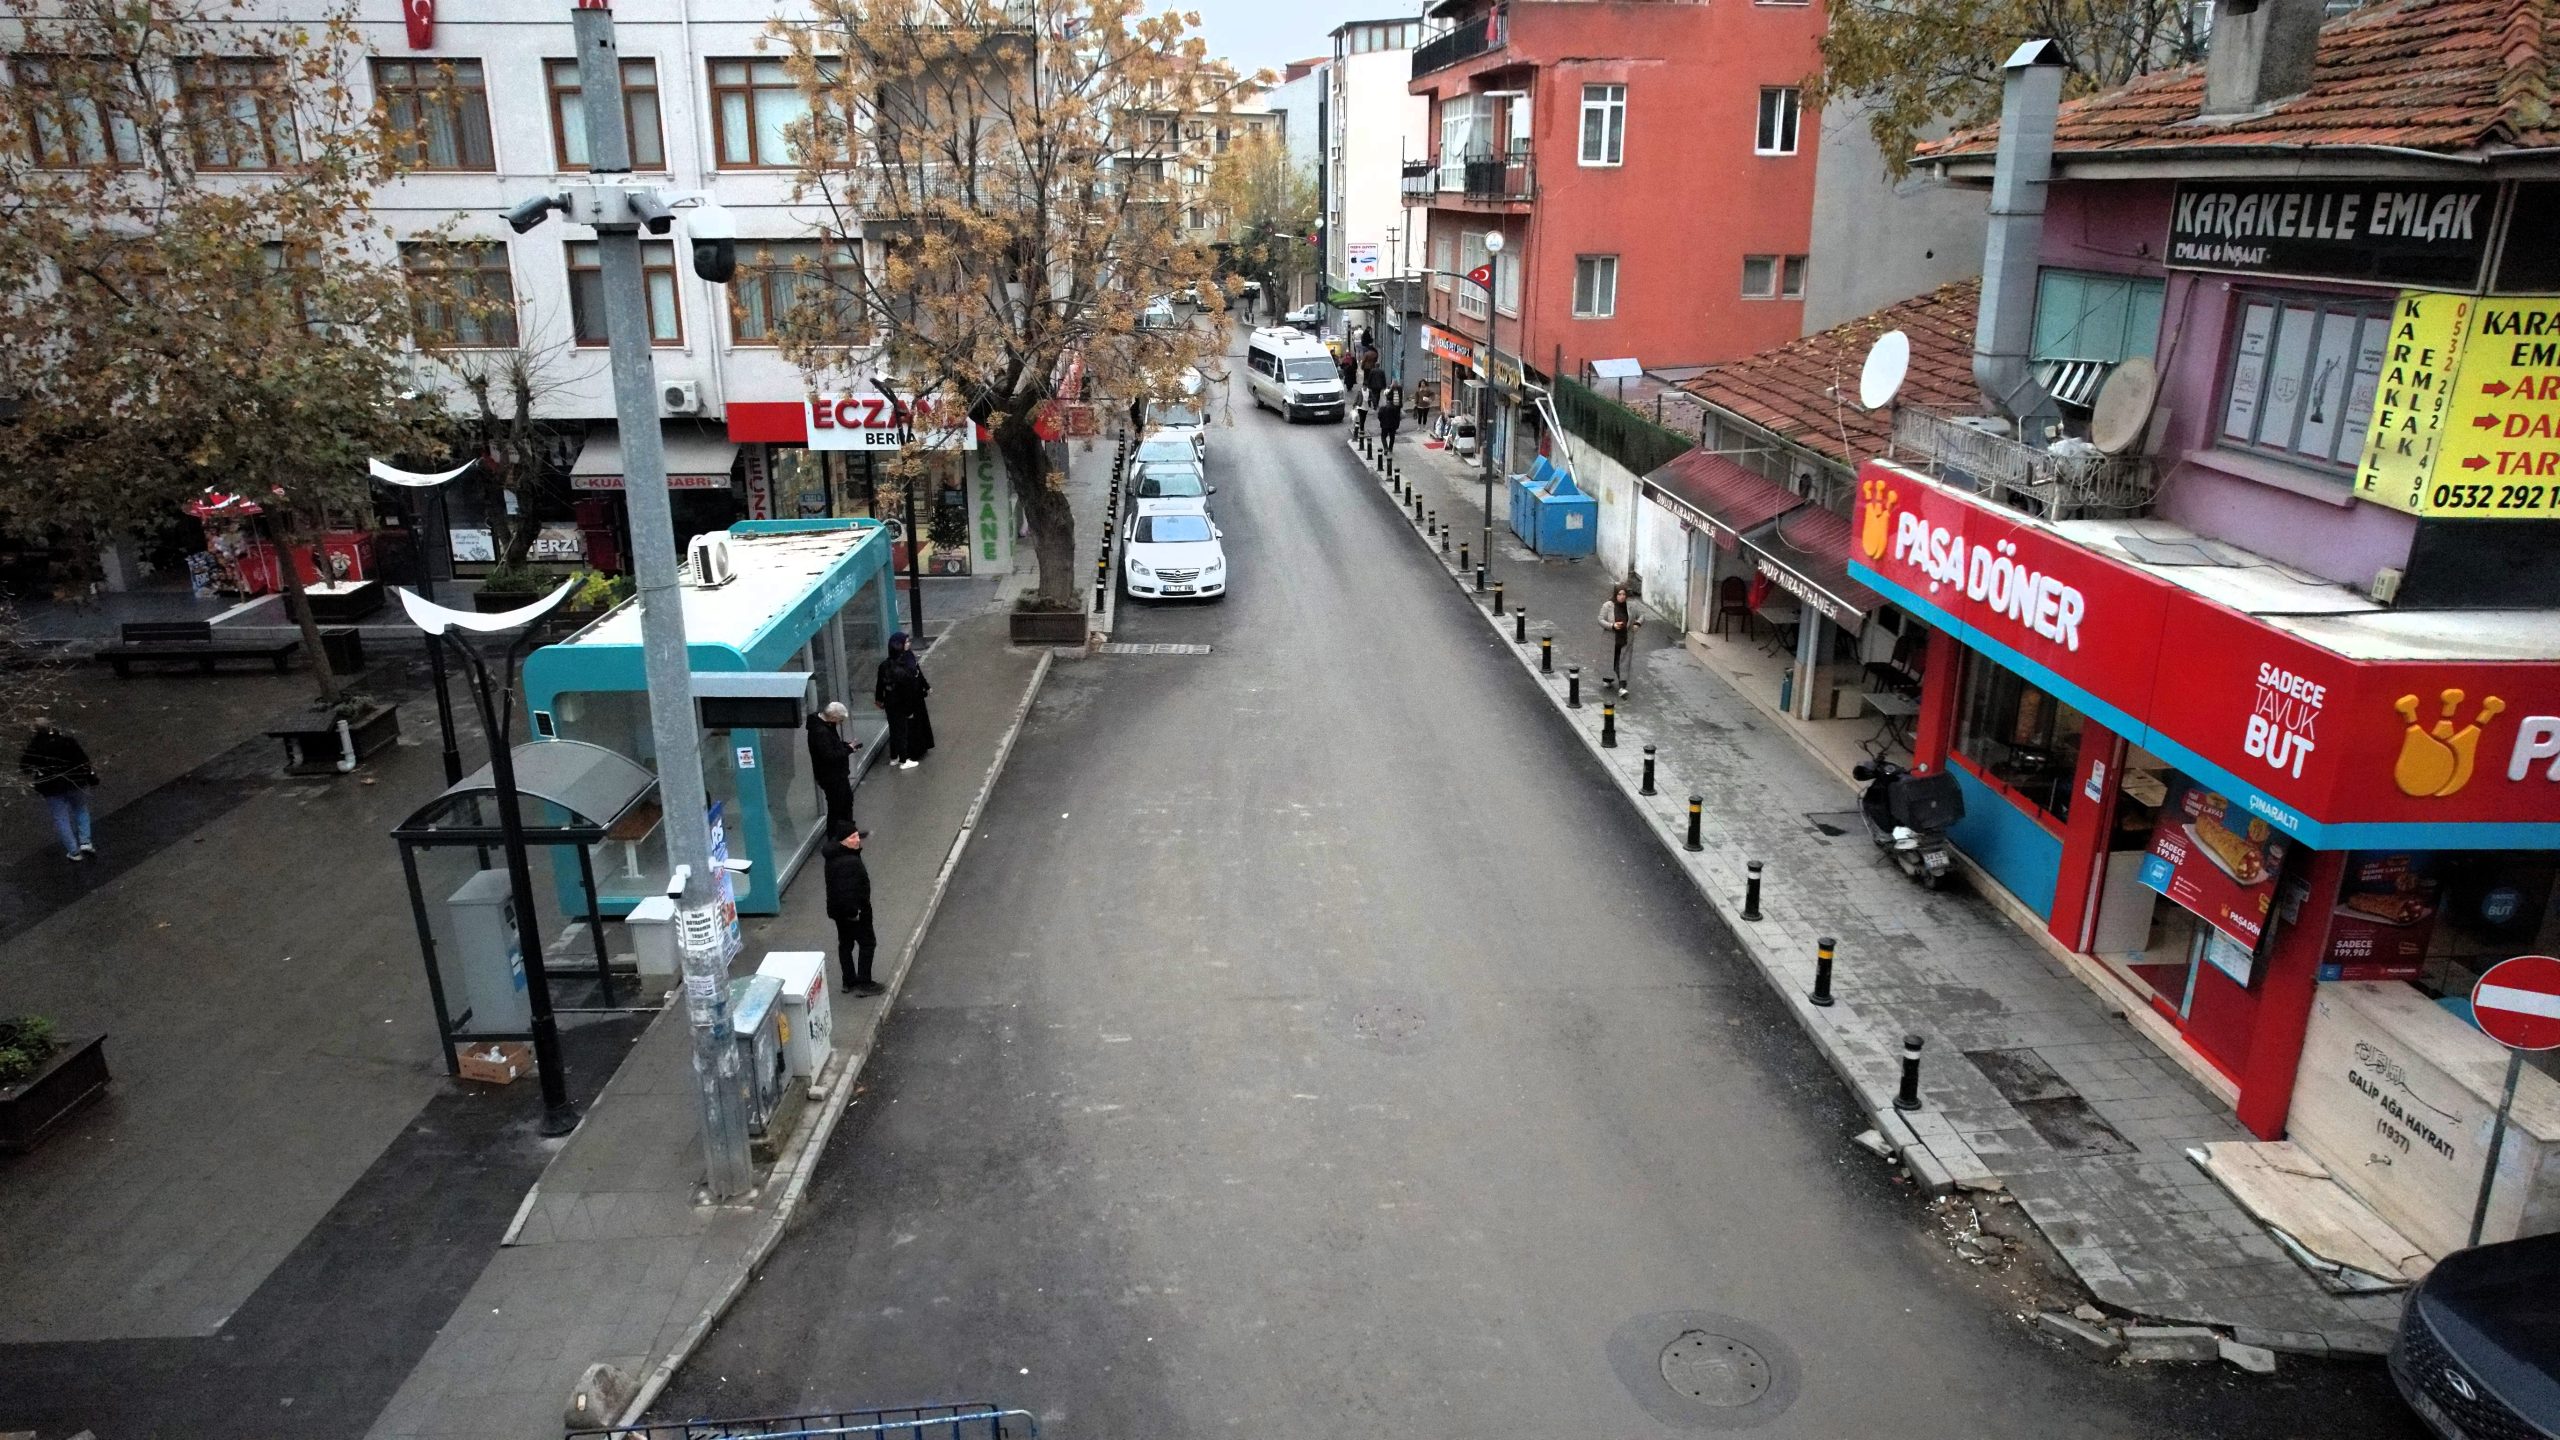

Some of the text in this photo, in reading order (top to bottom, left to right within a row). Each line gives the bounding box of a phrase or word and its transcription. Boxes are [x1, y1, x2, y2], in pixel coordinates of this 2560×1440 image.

[2175, 192, 2481, 243] KARAKELLE EMLAK
[2175, 242, 2210, 260] EMLAK
[2511, 342, 2560, 367] EM
[2363, 299, 2421, 493] KARAKELLE
[2397, 348, 2435, 457] EMLAK
[588, 477, 625, 488] KUA
[2433, 484, 2560, 509] 0532 292 1
[1895, 511, 2085, 652] PAŞA DÖNER
[2257, 662, 2326, 709] SADECE
[2255, 684, 2320, 740] TAVUK
[2244, 713, 2315, 780] BUT
[2508, 716, 2560, 782] P
[2250, 795, 2299, 831] ÇINARALTI
[2159, 838, 2187, 859] SADECE
[2487, 905, 2513, 916] BUT
[2336, 940, 2373, 949] SADECE
[2348, 1069, 2379, 1100] GALİP
[2380, 1095, 2403, 1122] AĞA
[2405, 1113, 2455, 1160] HAYRATI
[2376, 1118, 2410, 1154] (1937)
